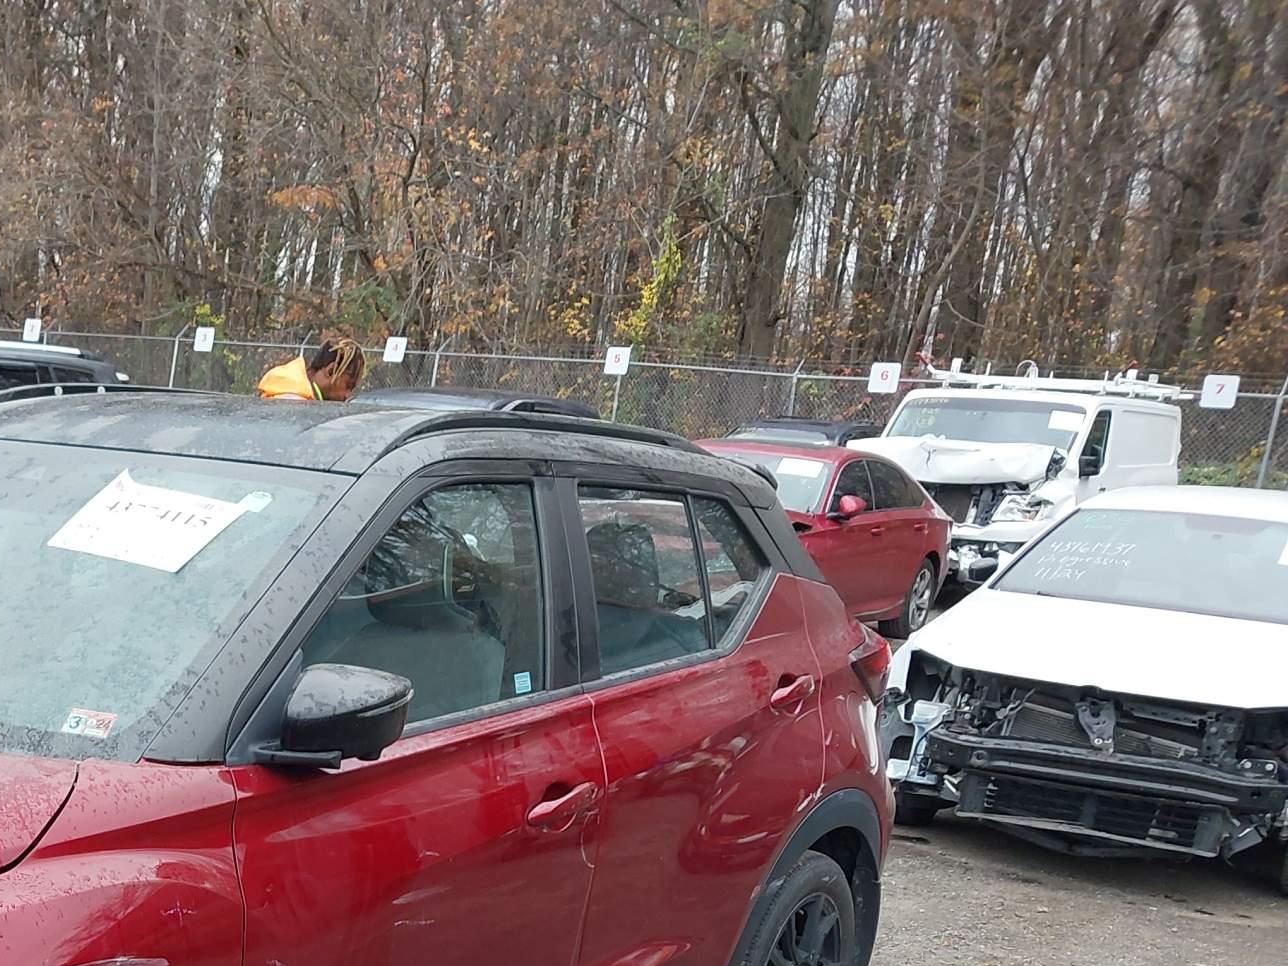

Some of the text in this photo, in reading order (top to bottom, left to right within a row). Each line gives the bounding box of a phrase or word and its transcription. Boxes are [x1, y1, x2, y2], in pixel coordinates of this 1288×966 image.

[614, 353, 621, 363] 5
[880, 370, 889, 381] 6
[1216, 383, 1226, 394] 7
[69, 715, 82, 729] 3
